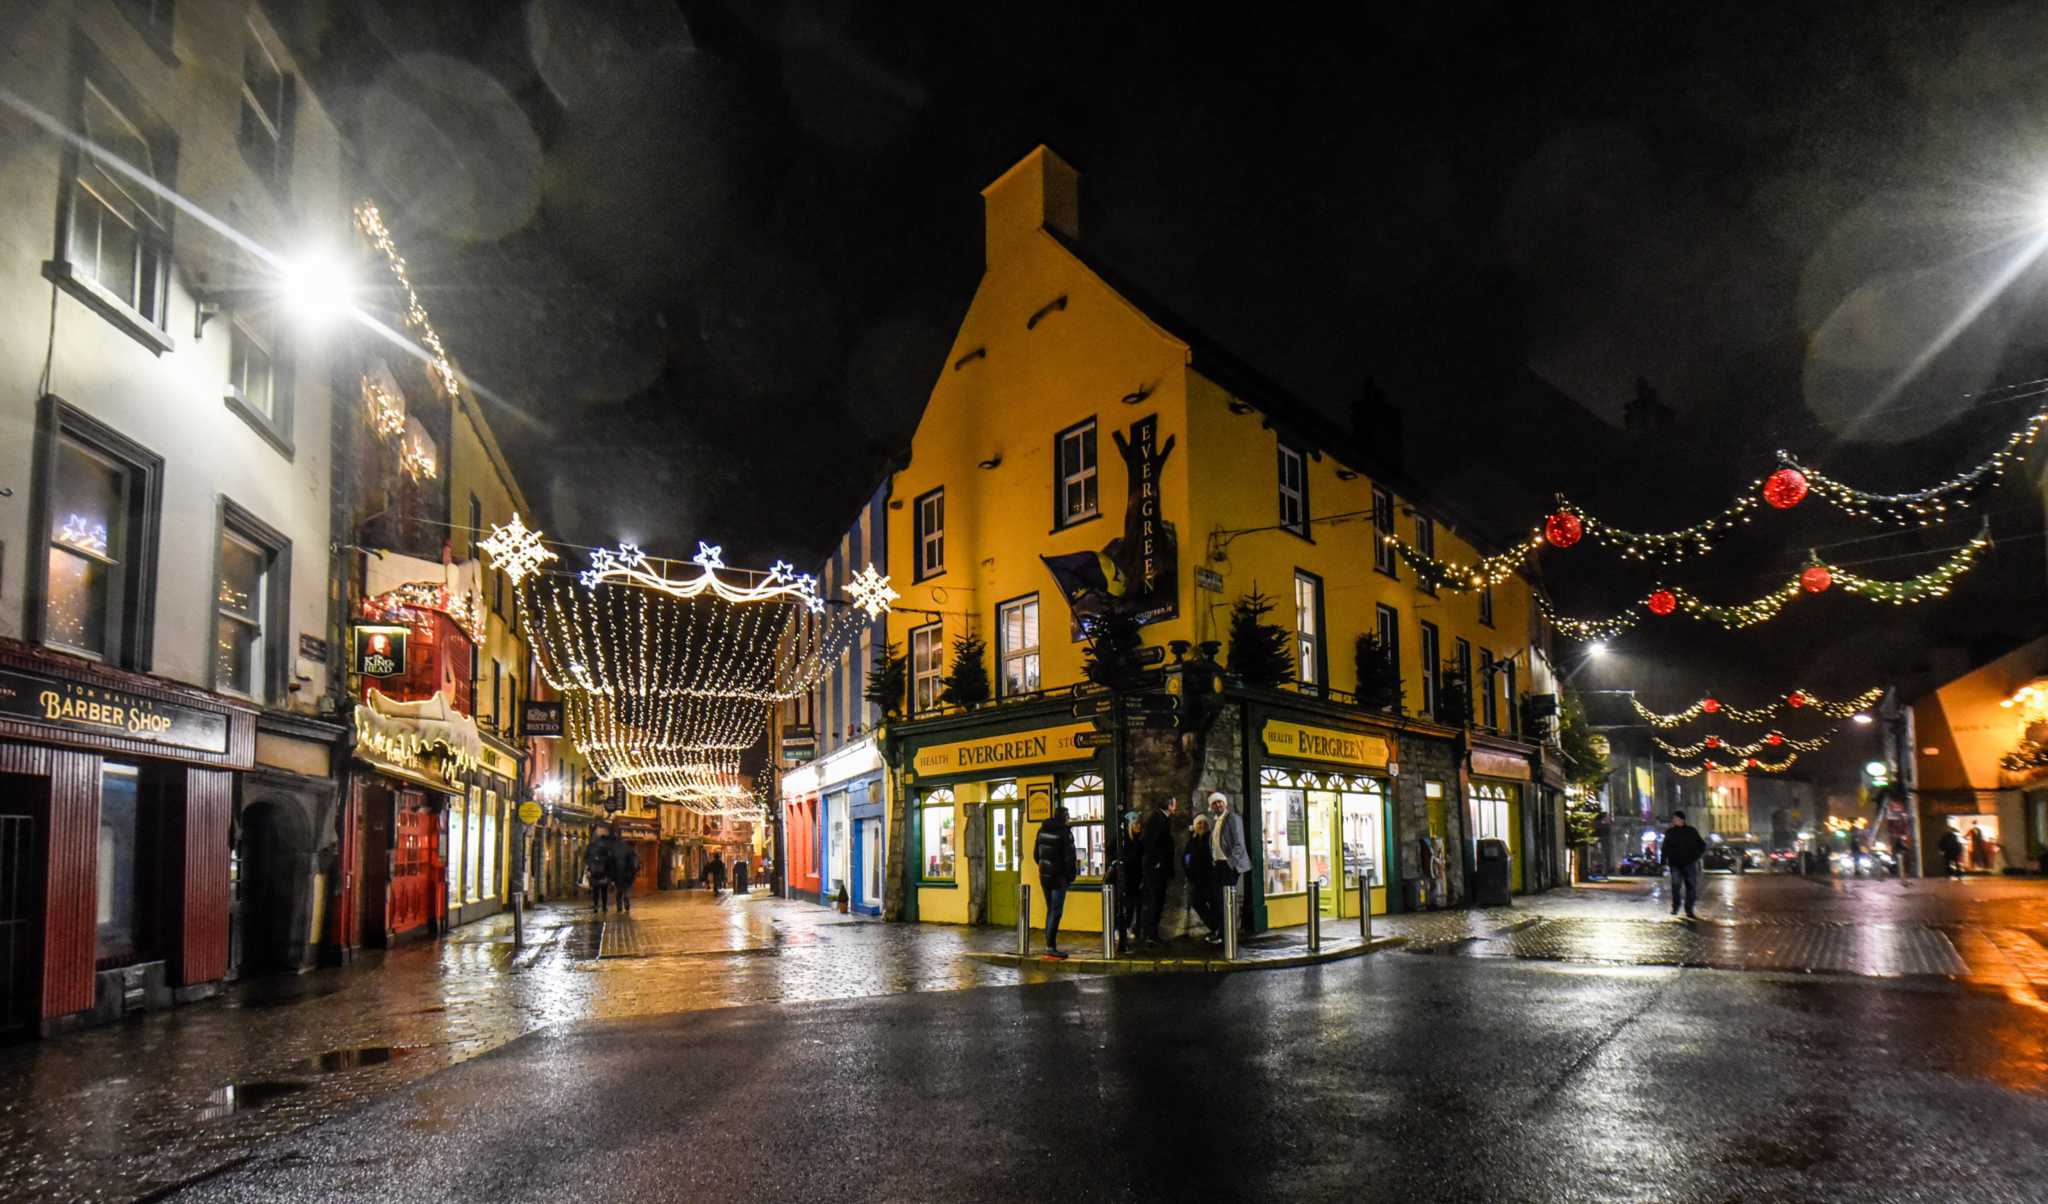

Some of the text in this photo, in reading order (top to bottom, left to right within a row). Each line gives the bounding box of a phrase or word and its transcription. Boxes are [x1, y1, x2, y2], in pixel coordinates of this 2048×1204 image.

[1141, 425, 1155, 594] EVERGREEN
[67, 684, 95, 697] TOM
[40, 691, 172, 733] BARBER SHOP
[920, 753, 950, 768] HEALTH
[958, 736, 1047, 766] EVERGREEN
[1267, 729, 1293, 745] HEALTH
[1298, 730, 1364, 758] EVERGREEN
